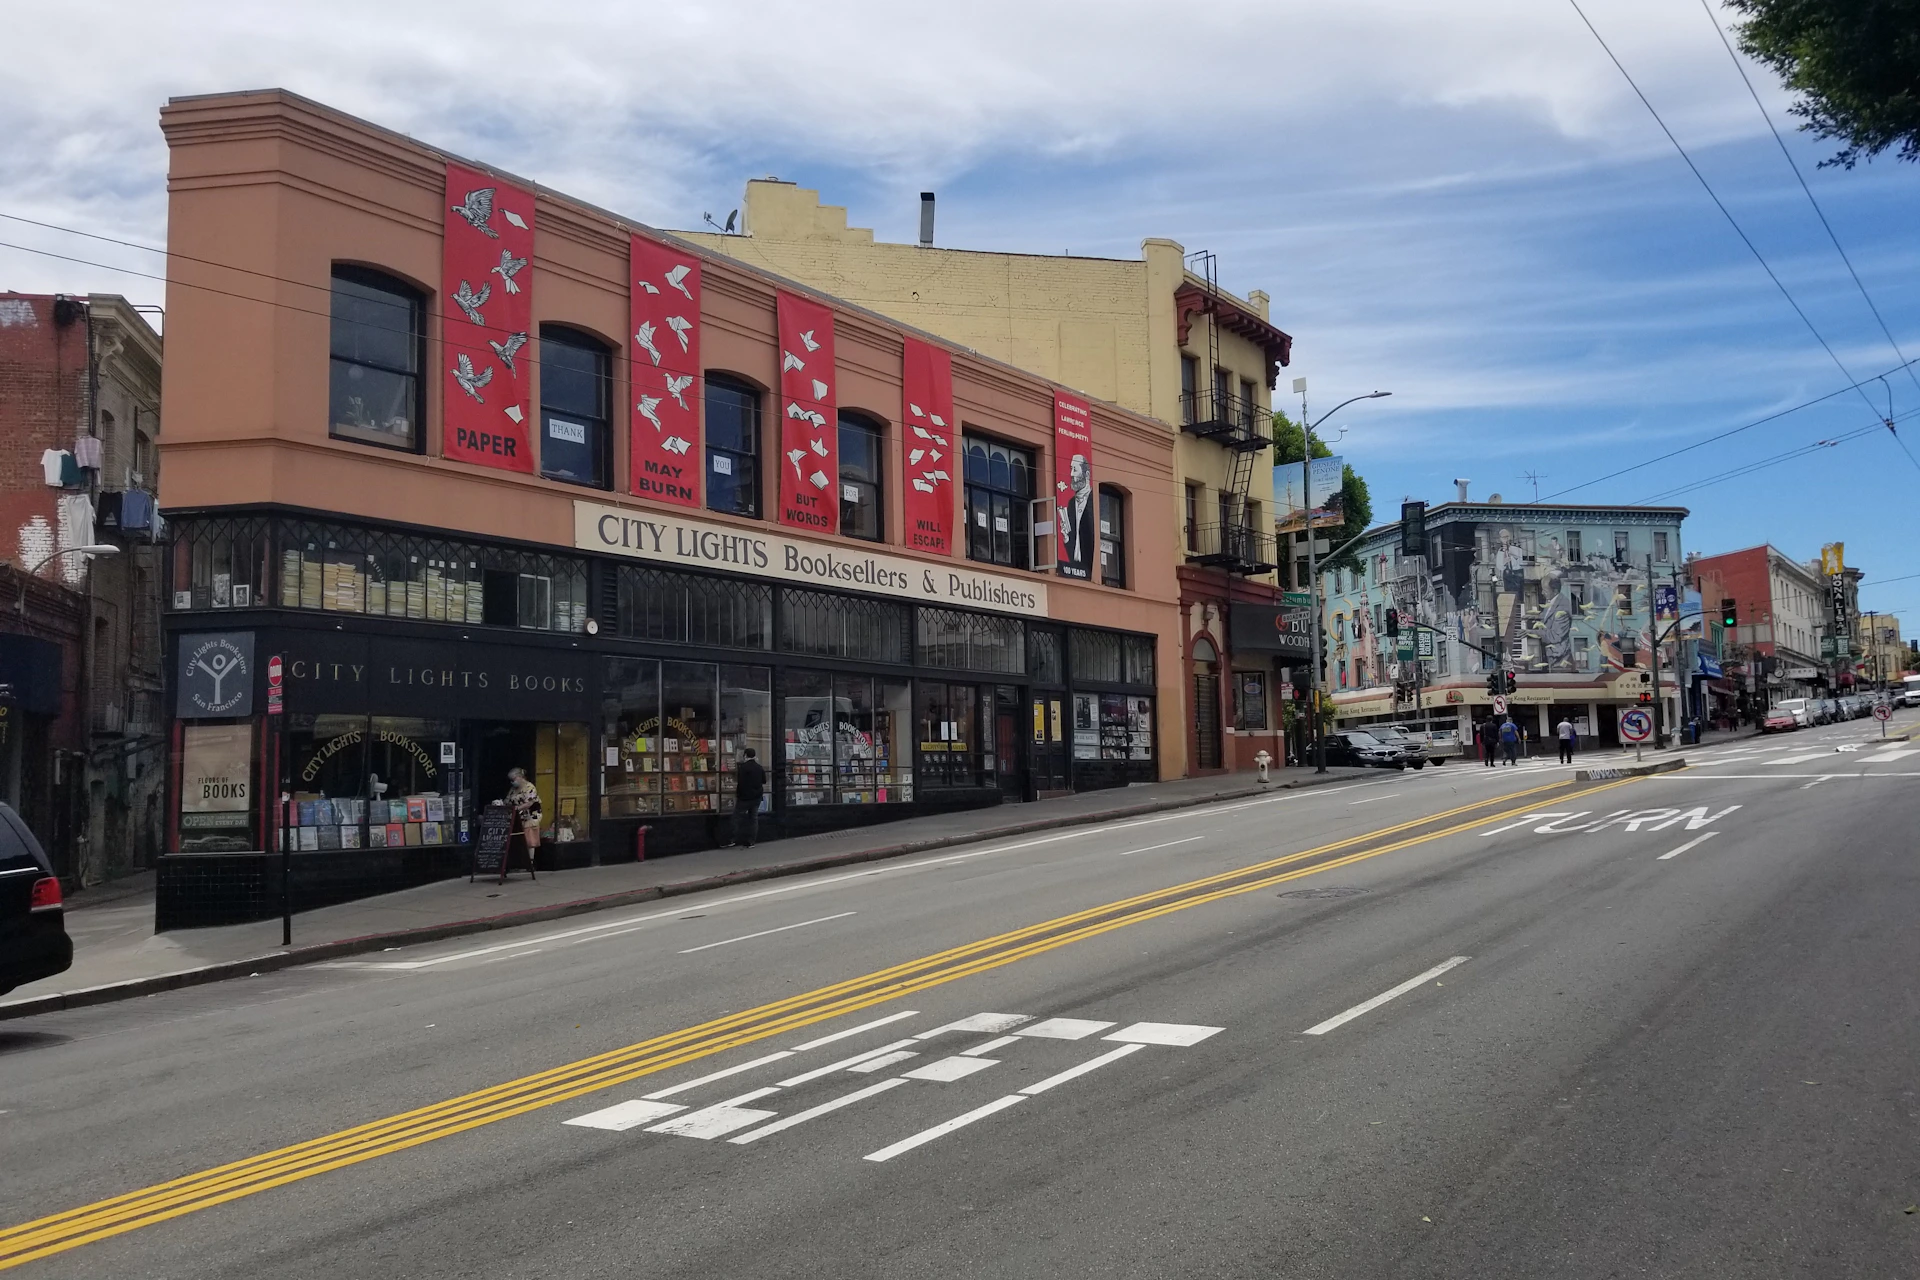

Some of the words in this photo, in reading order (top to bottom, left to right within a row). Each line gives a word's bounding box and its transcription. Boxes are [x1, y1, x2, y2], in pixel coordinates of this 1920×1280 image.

[1058, 401, 1088, 417] CELEBRATING
[1060, 414, 1085, 429] LAWRENCE
[551, 424, 584, 440] THANK
[457, 427, 517, 458] PAPER
[644, 460, 683, 479] MAY
[715, 459, 730, 470] YOU
[639, 477, 692, 500] BURN
[845, 488, 857, 499] FOR
[796, 493, 818, 508] BUT
[786, 508, 828, 527] WORDS
[917, 519, 941, 533] WILL
[913, 533, 945, 549] ESCAPE
[598, 514, 667, 552] CITY
[676, 527, 768, 569] LIGHTS
[784, 544, 908, 589] Booksellers
[922, 569, 938, 594] &
[948, 574, 1036, 609] Publishers
[1063, 565, 1071, 575] 100
[1071, 566, 1087, 578] YEARS
[1832, 573, 1844, 600] MONA
[1283, 612, 1310, 621] BROADWAY
[1835, 602, 1845, 629] LISA
[186, 657, 198, 677] City
[193, 640, 218, 658] Lights
[219, 639, 247, 675] Bookstore
[292, 661, 364, 682] CITY
[389, 667, 489, 688] LIGHTS
[509, 674, 585, 693] BOOKS
[192, 693, 206, 709] San
[206, 691, 243, 712] Francisco
[632, 716, 660, 740] LIGHTS
[667, 716, 705, 760] BOOKSTORE
[807, 721, 830, 740] LIGHTS
[839, 721, 872, 756] BOOKSTORE
[302, 753, 325, 782] CITY
[322, 730, 362, 759] LIGHTS
[380, 730, 438, 779] BOOKSTORE
[221, 776, 229, 784] OF
[203, 783, 245, 799] BOOKS
[183, 815, 215, 827] OPEN
[1479, 805, 1743, 836] TURN
[482, 834, 509, 842] LIGHTS
[487, 827, 507, 836] CITY
